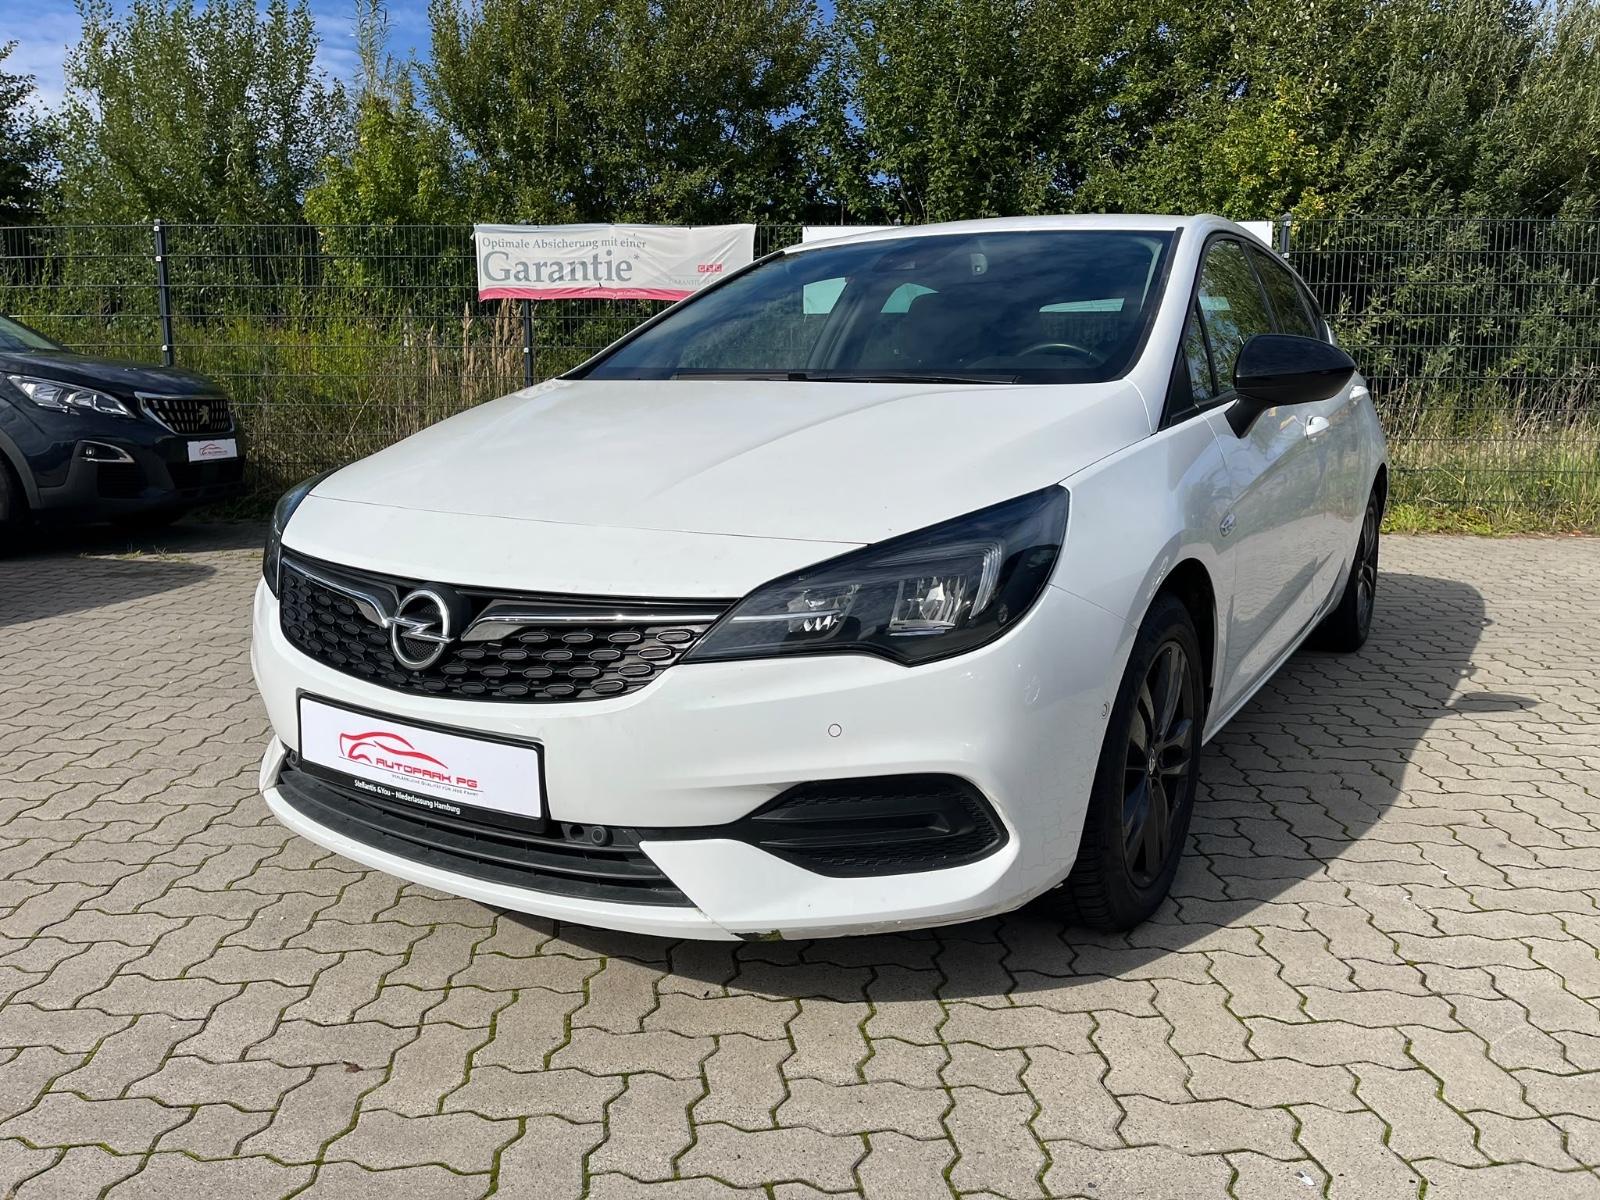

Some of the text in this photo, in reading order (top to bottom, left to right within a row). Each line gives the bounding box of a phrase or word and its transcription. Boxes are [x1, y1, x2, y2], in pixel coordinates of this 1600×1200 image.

[482, 235, 647, 249] Optimale Absicherung mit einer
[376, 758, 478, 789] AUTOPARK PG
[354, 780, 376, 792] Stellantis
[395, 791, 433, 808] Niederlassung
[434, 801, 460, 814] Hamburg
